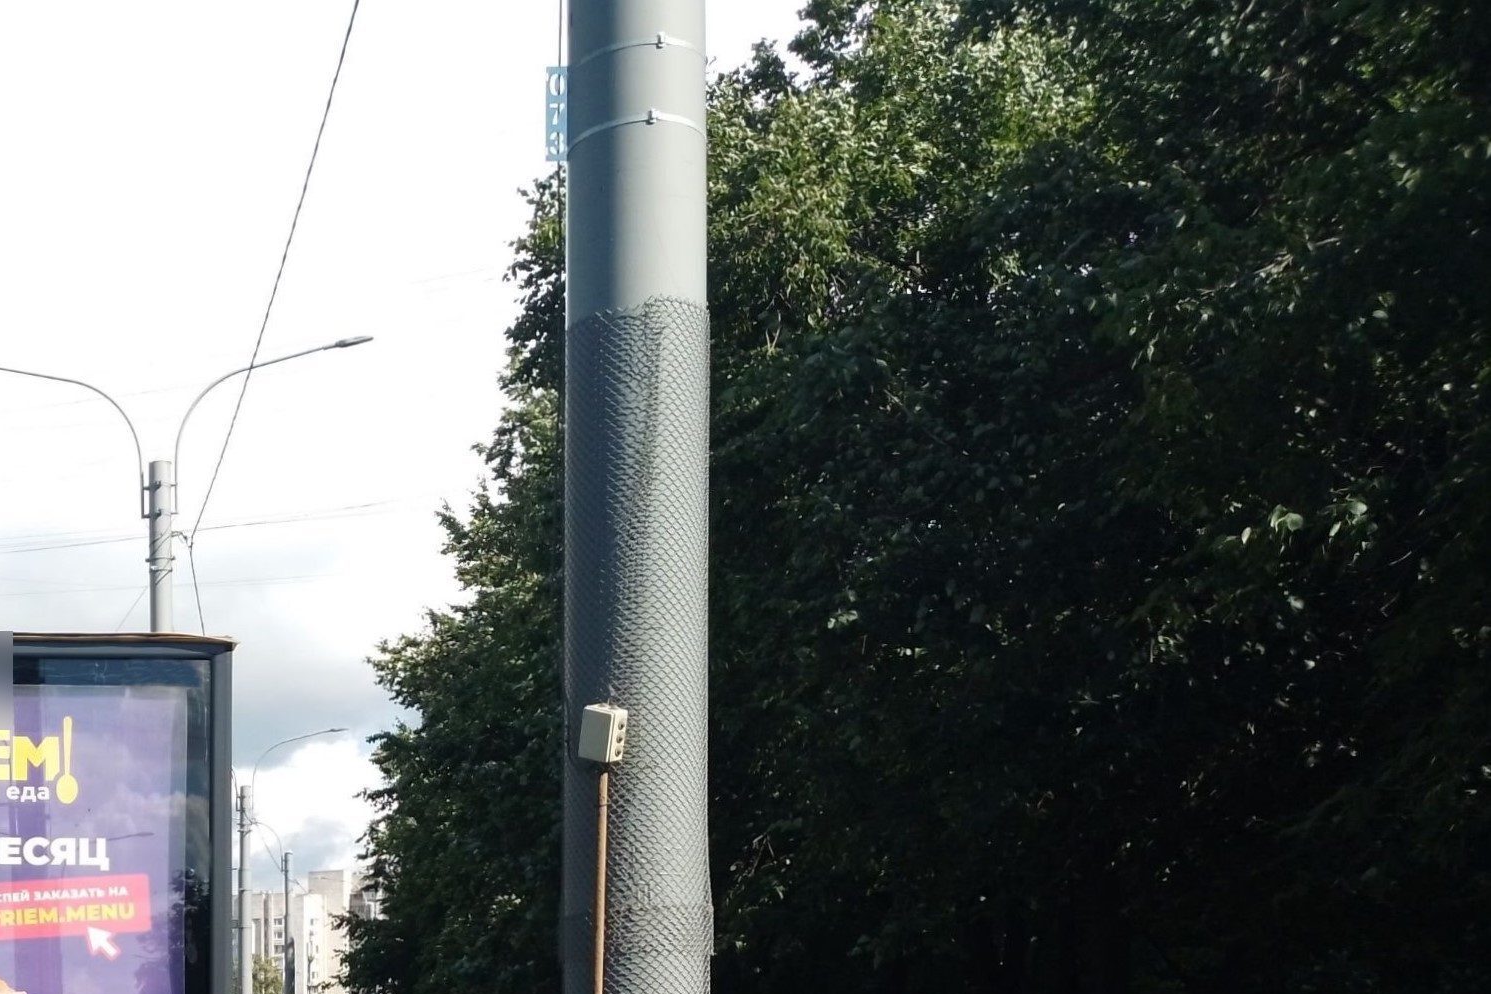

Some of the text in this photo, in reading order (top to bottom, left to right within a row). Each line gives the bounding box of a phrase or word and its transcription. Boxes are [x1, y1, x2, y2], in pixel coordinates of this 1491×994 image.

[6, 786, 50, 802] еда
[34, 887, 105, 900] ЗАКАЗАТЬ
[109, 886, 128, 896] НА
